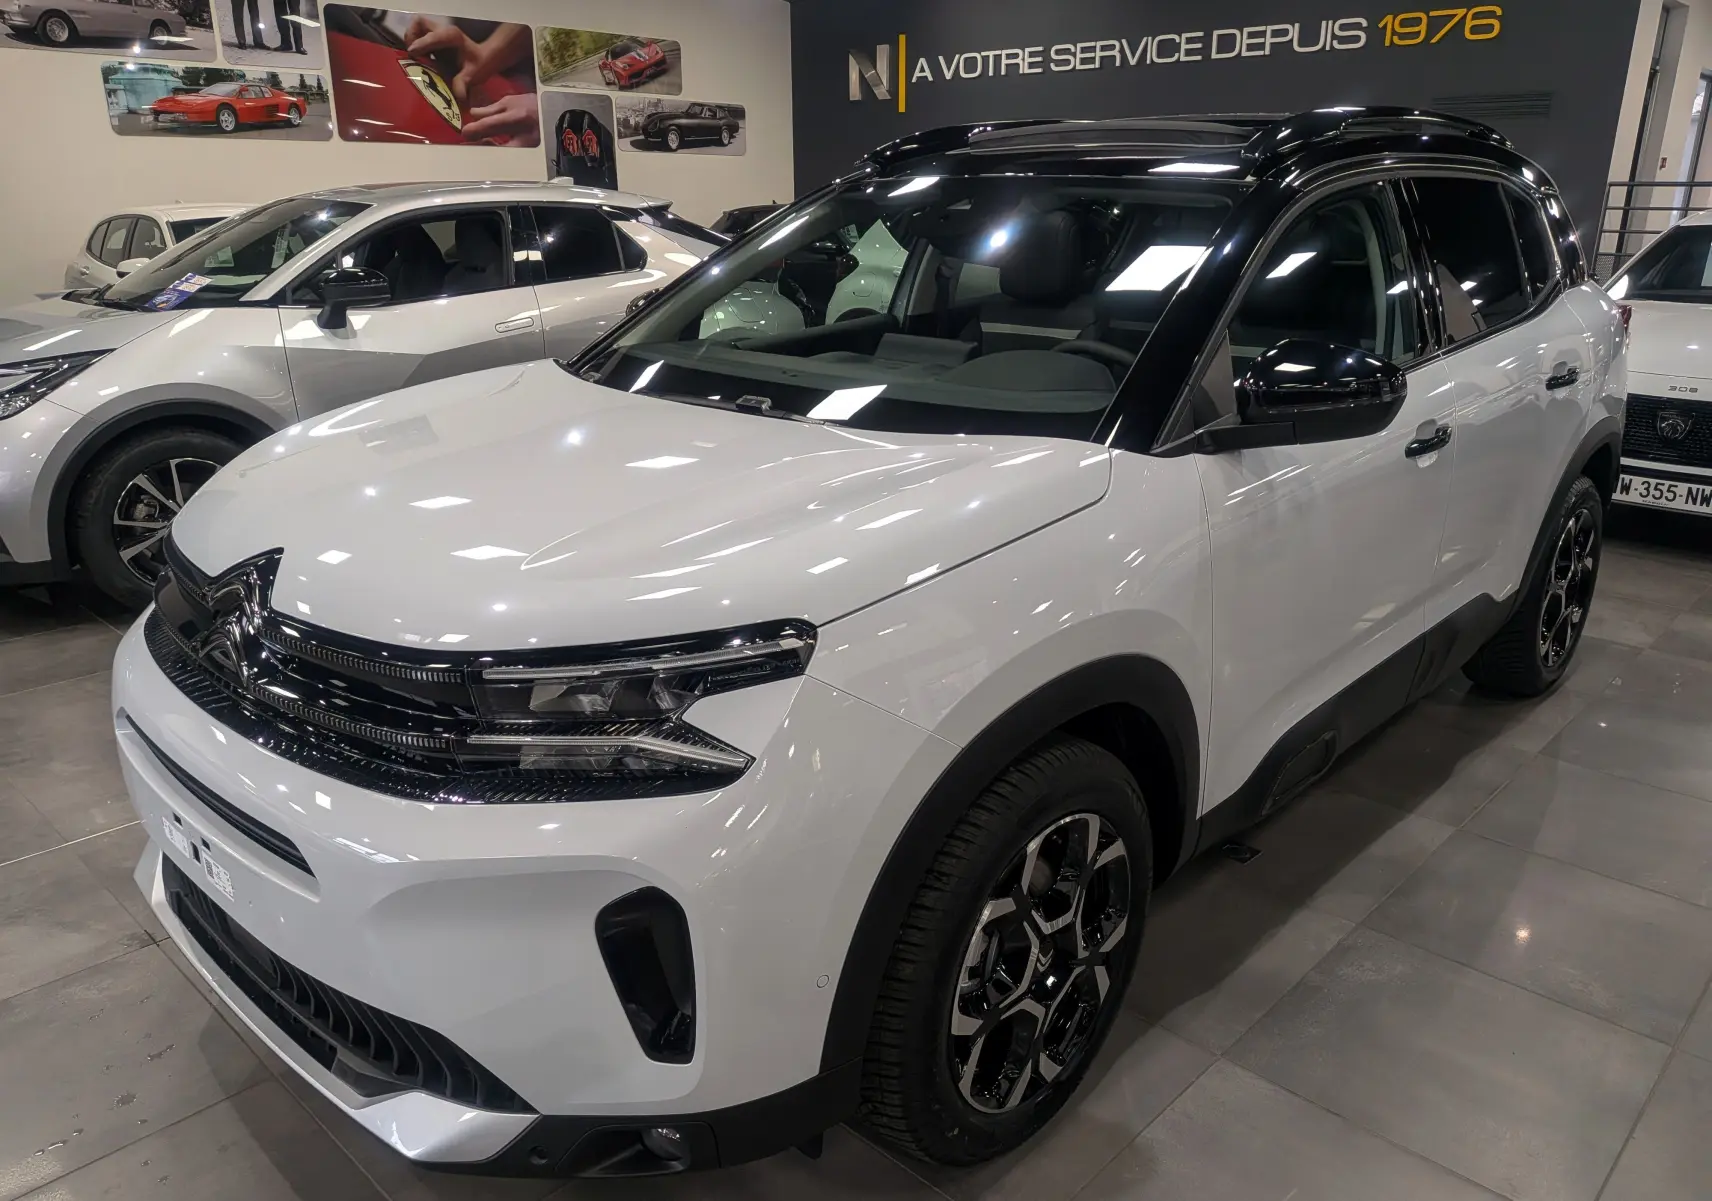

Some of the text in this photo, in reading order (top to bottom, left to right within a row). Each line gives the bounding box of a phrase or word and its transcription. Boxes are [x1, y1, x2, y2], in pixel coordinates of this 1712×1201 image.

[911, 5, 1503, 83] A VOTRE SERVICE DEPUIS 1976
[1612, 476, 1712, 508] W-355-NW
